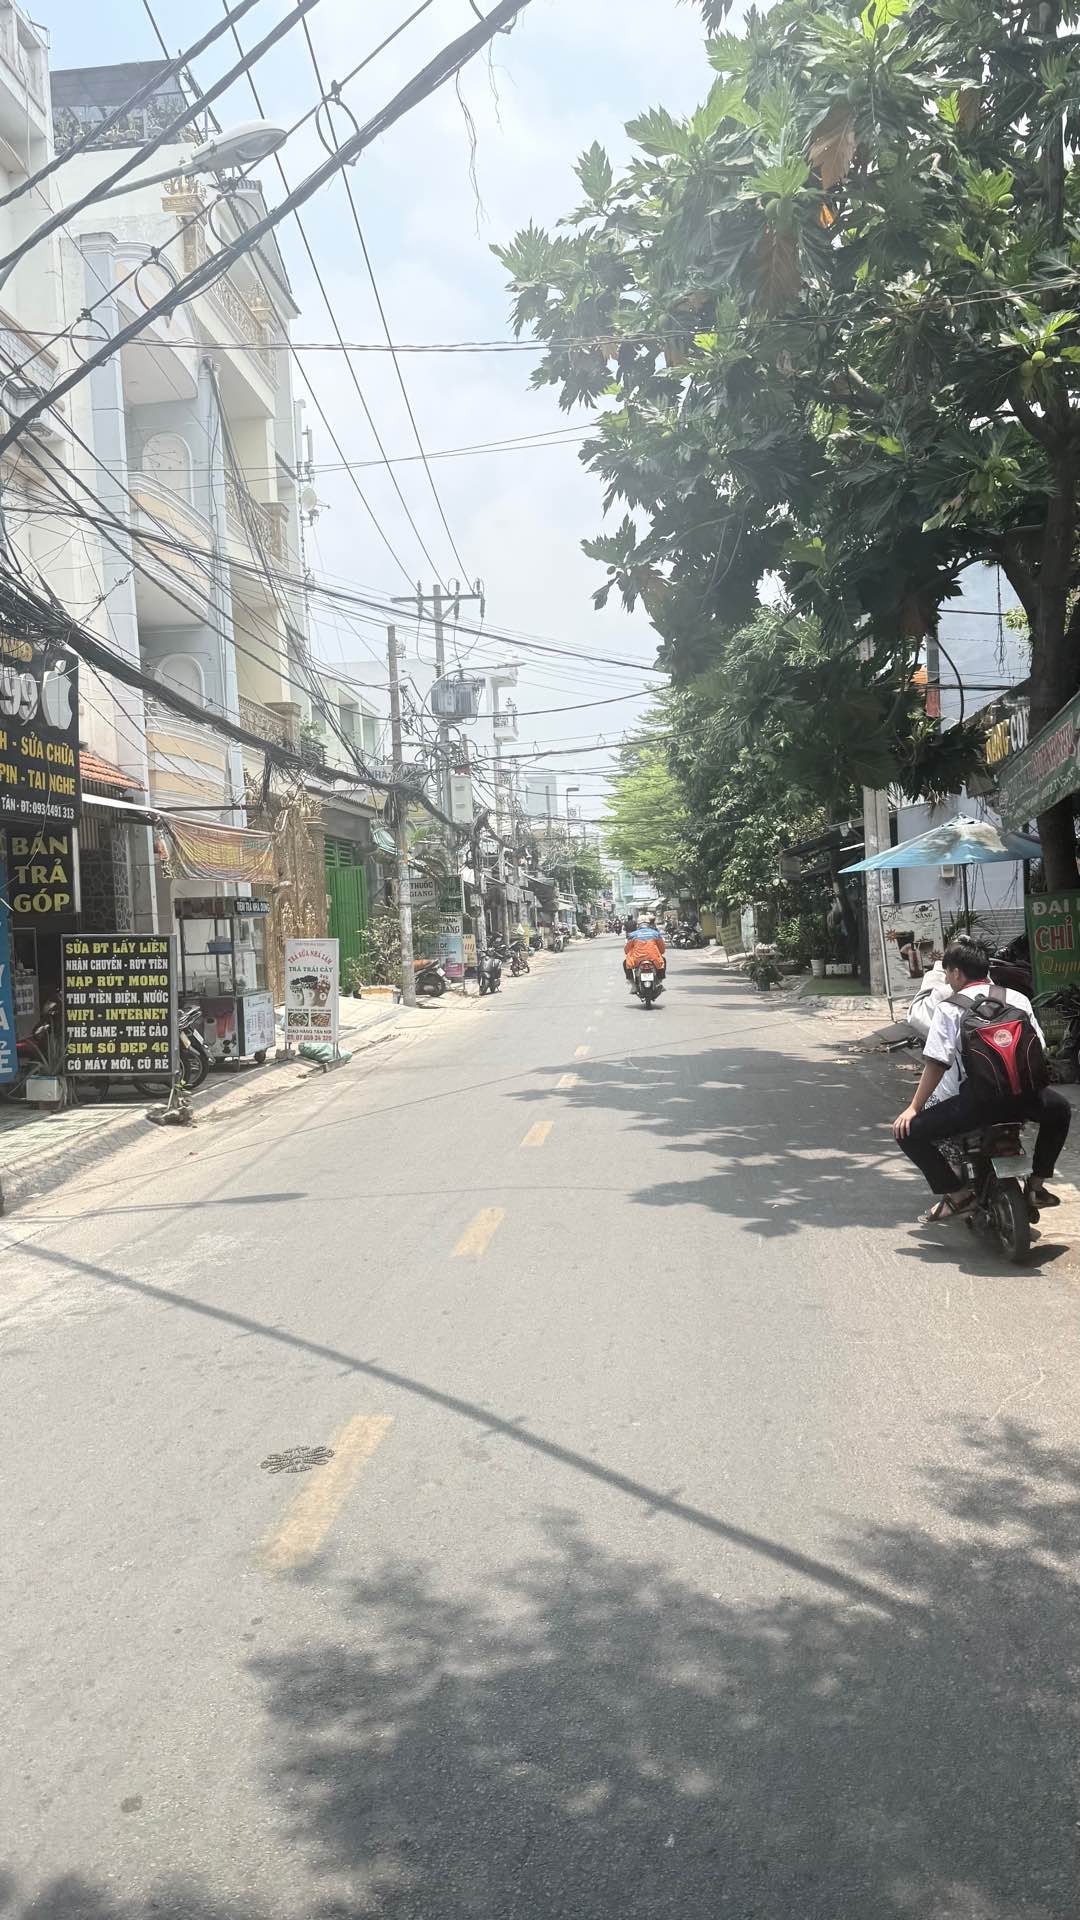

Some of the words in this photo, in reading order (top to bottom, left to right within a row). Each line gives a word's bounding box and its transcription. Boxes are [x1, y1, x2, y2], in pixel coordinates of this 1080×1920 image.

[21, 731, 44, 759] SỬA
[46, 742, 75, 767] CHỮA
[27, 769, 46, 791] TAI
[49, 773, 76, 796] NGHE
[11, 831, 68, 855] BÁN
[14, 858, 68, 884] TRẢ
[13, 888, 70, 913] GÓP
[1031, 899, 1069, 917] ĐẠI
[1035, 914, 1073, 953] CHỈ
[65, 939, 89, 954] SỬA
[93, 942, 109, 954] ĐT
[112, 938, 136, 953] LẤY
[139, 938, 168, 953] LIỀN
[65, 957, 88, 973] NHẬN
[90, 954, 122, 970] CHUYỂN
[129, 956, 146, 970] RÚT
[148, 954, 168, 970] TIỀN
[66, 976, 93, 990] NẠP
[97, 973, 124, 987] RÚT
[128, 975, 168, 986] MOMO
[66, 993, 86, 1004] THU
[88, 989, 112, 1004] TIỀN
[143, 989, 169, 1003] NƯỚC
[66, 1009, 94, 1021] WIFI
[105, 1008, 168, 1020] INTERNET
[66, 1022, 88, 1038] THẺ
[90, 1026, 117, 1037] GAME
[125, 1021, 146, 1037] THẺ
[67, 1042, 93, 1054] SIM
[97, 1039, 116, 1053] SỐ
[120, 1042, 148, 1056] ĐẸP
[151, 1042, 169, 1053] 4G
[67, 1057, 81, 1071] CÓ
[84, 1057, 108, 1070] MÁY
[110, 1056, 134, 1071] MỚI,
[137, 1056, 151, 1069] CŨ
[154, 1054, 169, 1069] RẺ
